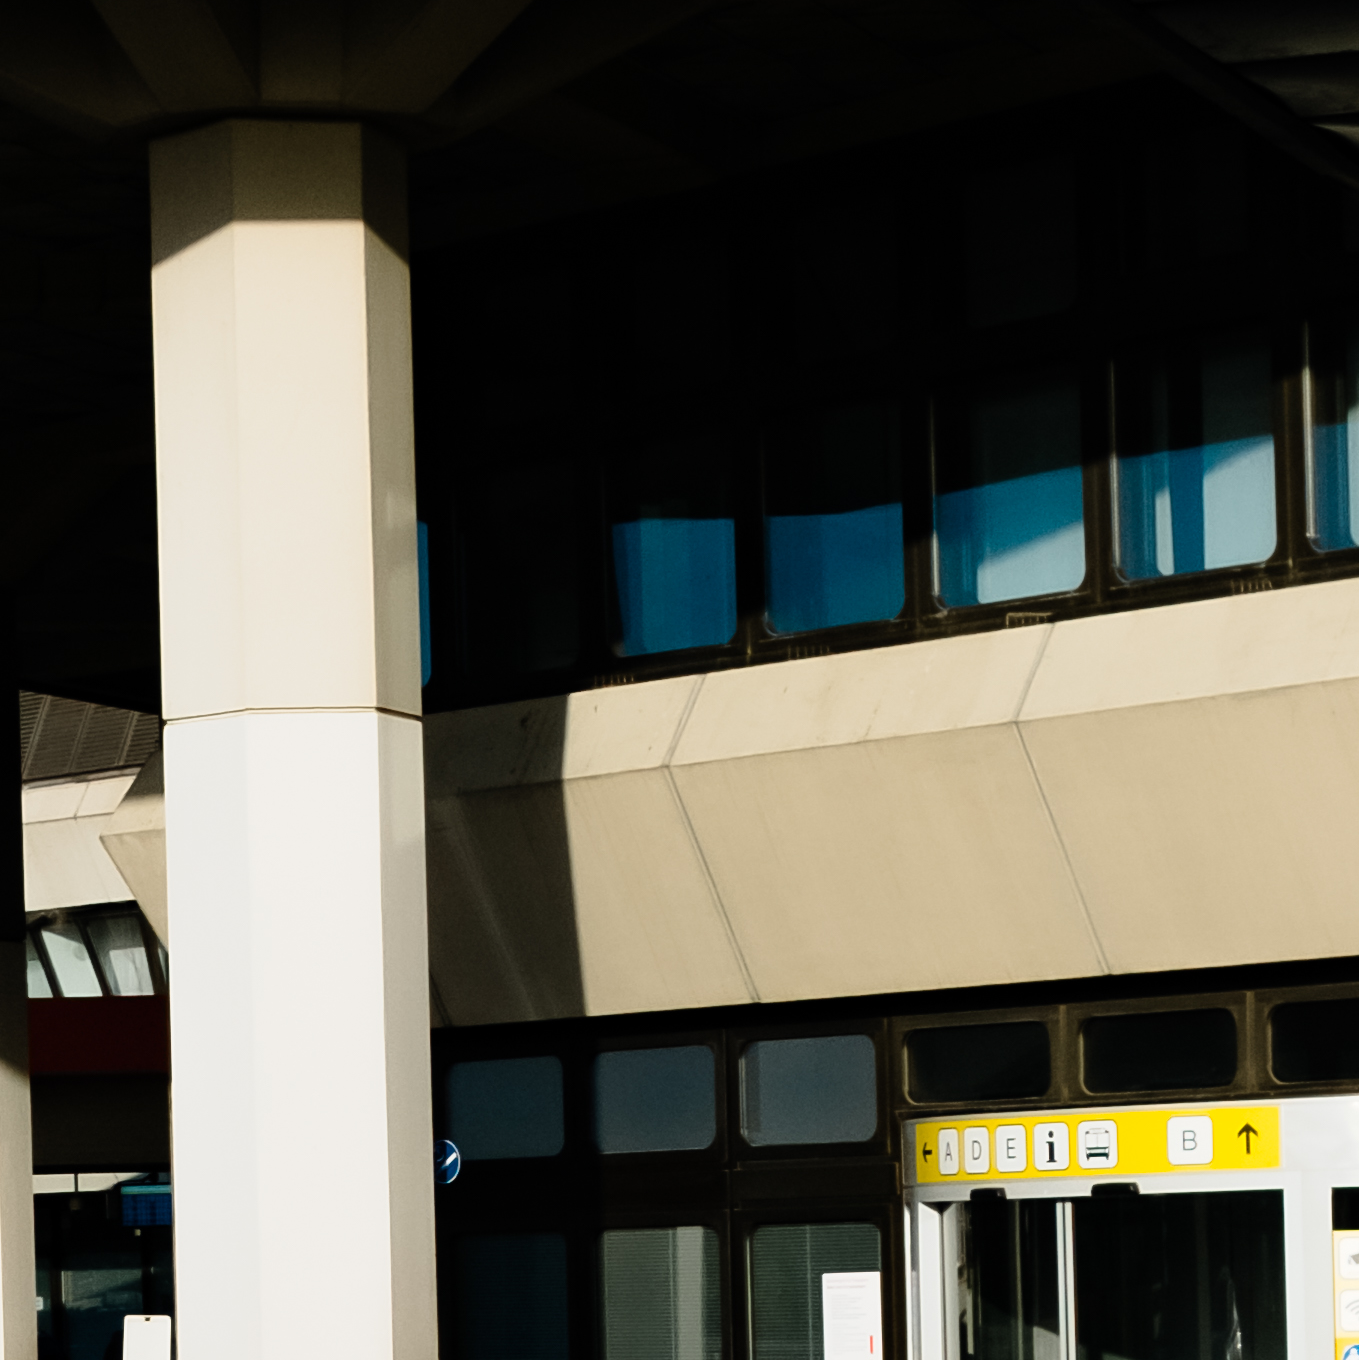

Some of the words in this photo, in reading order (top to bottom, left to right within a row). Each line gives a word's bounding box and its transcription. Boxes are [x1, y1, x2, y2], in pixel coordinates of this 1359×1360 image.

[944, 1141, 953, 1162] A
[971, 1139, 982, 1161] D
[1006, 1137, 1017, 1159] E
[1045, 1130, 1057, 1163] i
[1182, 1129, 1198, 1151] B
